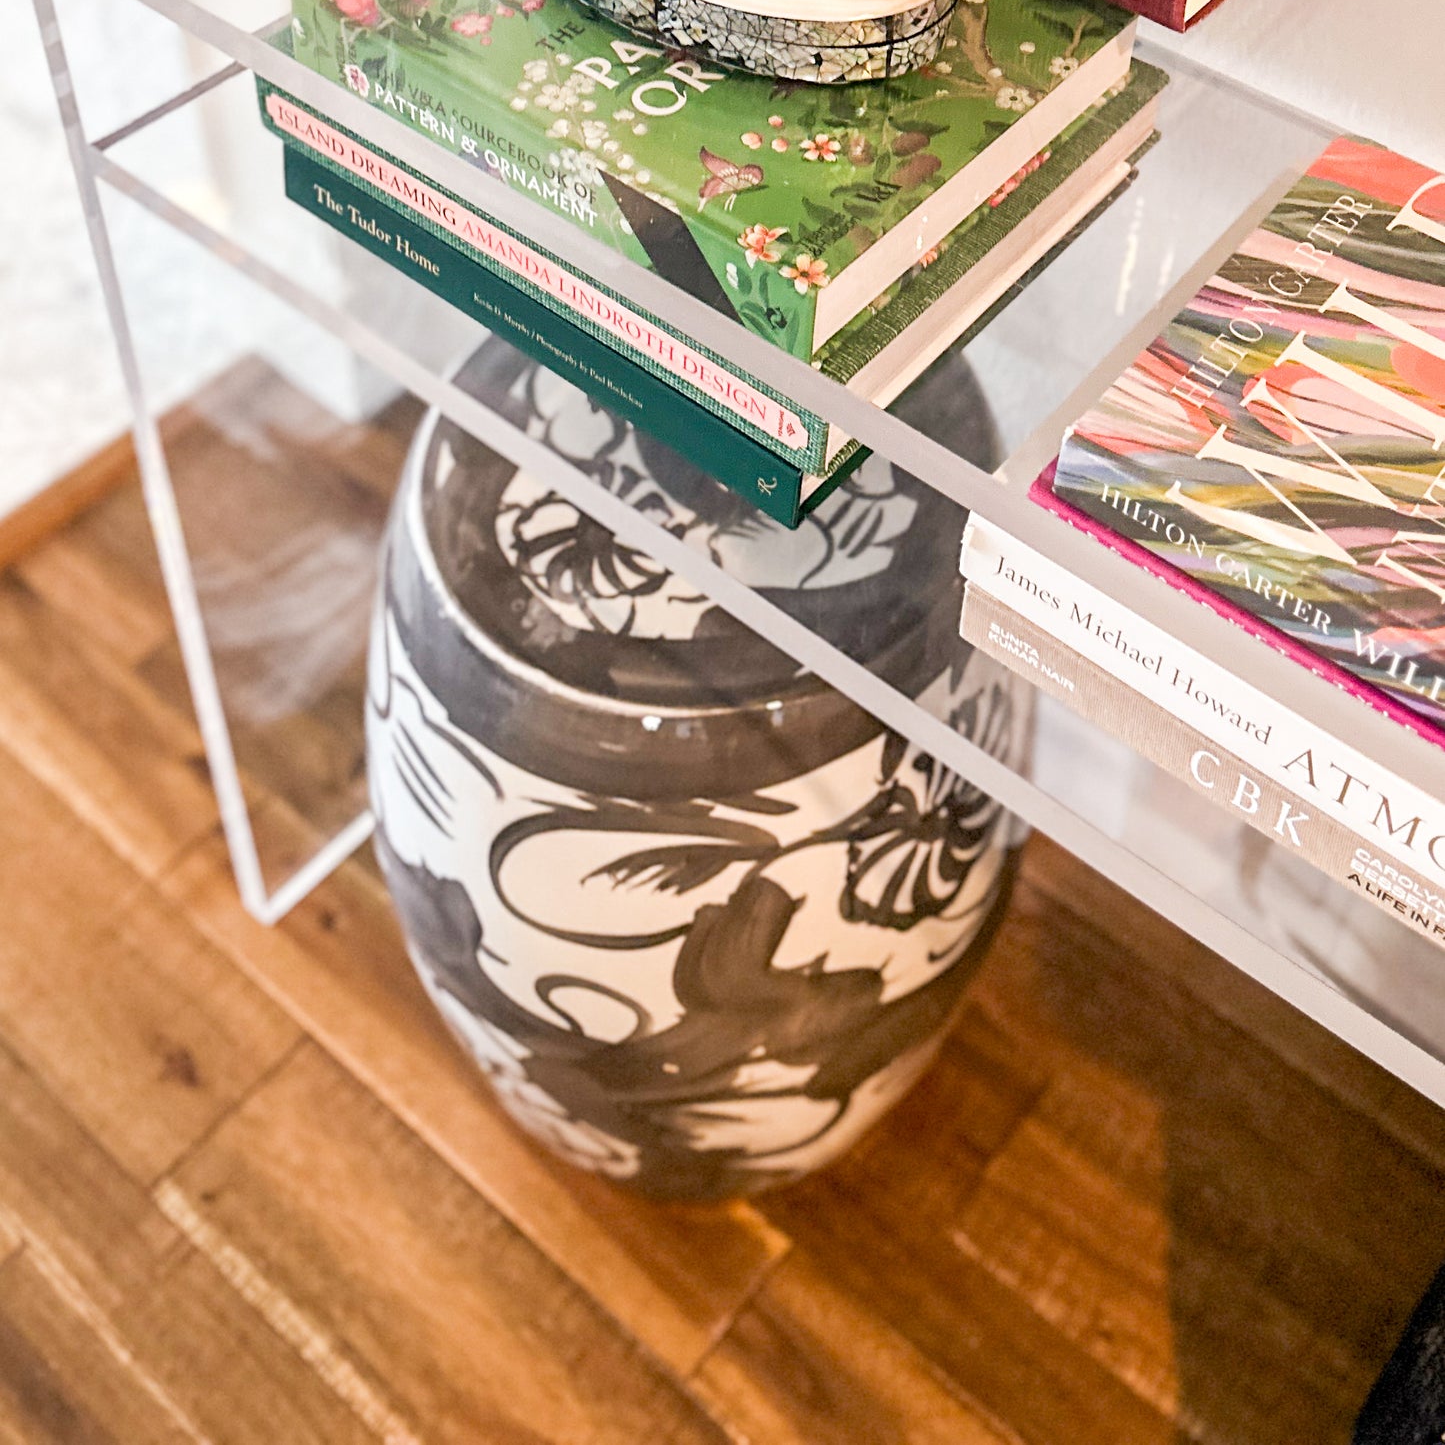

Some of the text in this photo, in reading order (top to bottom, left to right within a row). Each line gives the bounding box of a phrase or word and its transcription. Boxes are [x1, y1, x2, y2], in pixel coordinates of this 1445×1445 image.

[535, 20, 586, 52] THE
[278, 105, 457, 227] ISLAND DREAMING
[374, 81, 599, 228] PATTERN & ORNAMENT
[451, 110, 569, 190] SOURCEBOOK
[573, 180, 598, 205] OF
[313, 183, 441, 275] The Tudor Home
[462, 220, 767, 421] AMANDA LINDROTH DESIGN
[1170, 194, 1374, 409] HILTON CARTER
[1100, 483, 1207, 560] HILTON
[1214, 551, 1332, 636] CARTER
[987, 630, 1076, 693] KUMAR NAIR
[988, 621, 1040, 660] SUNITA
[992, 555, 1062, 611] James
[1069, 602, 1164, 676] Michael
[1170, 667, 1273, 746] Howard
[1347, 873, 1430, 929] A LIFE IN
